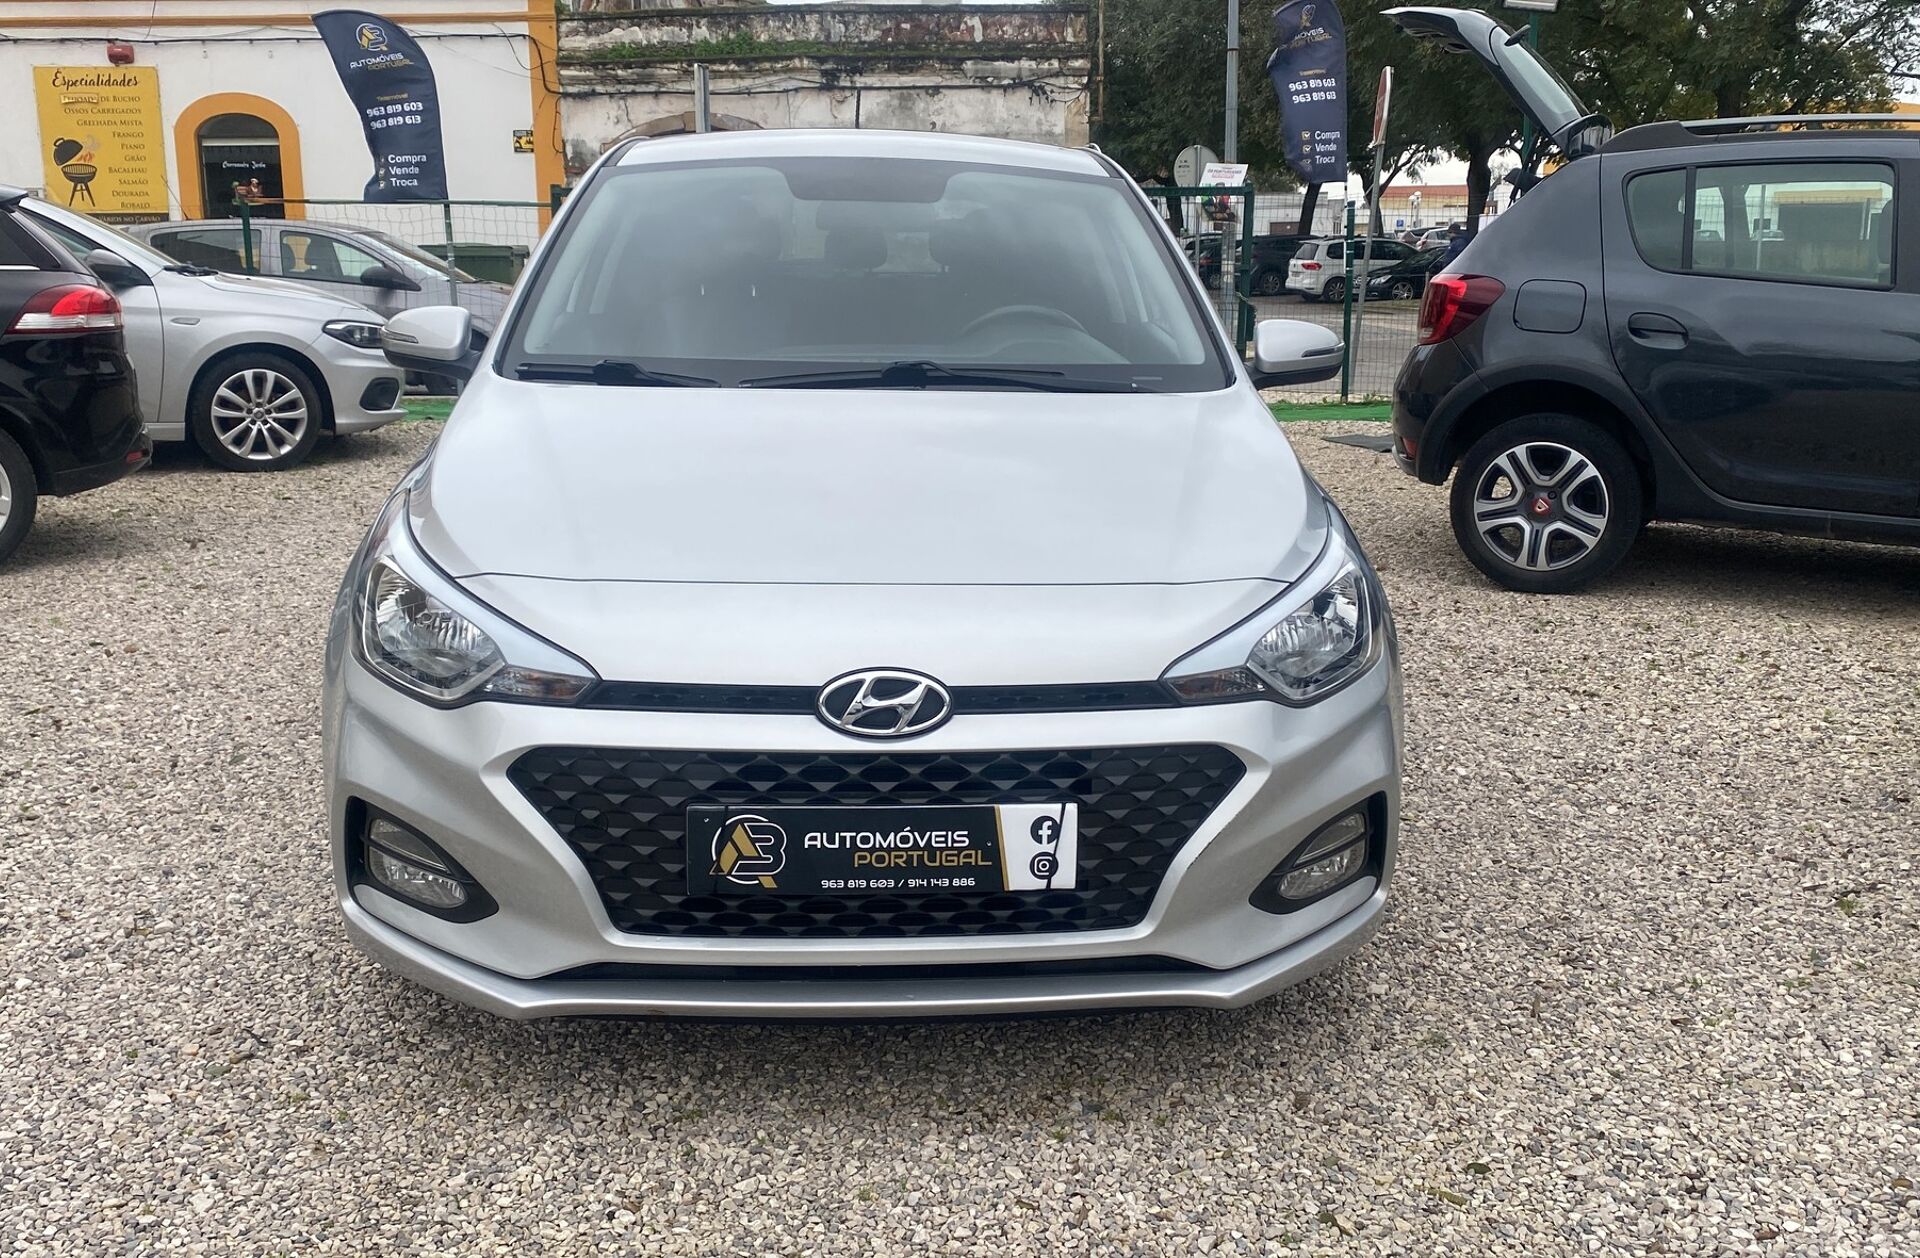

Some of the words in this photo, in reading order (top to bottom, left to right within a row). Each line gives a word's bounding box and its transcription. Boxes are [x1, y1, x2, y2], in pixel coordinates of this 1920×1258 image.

[349, 52, 404, 69] AUTOMÓVEIS
[52, 68, 138, 91] Especialidades
[1288, 81, 1308, 92] 963
[1323, 78, 1336, 87] 603
[113, 95, 141, 103] BUCHO
[1292, 93, 1311, 104] 963
[1312, 91, 1326, 101] 819
[64, 107, 89, 115] OSSOS
[90, 107, 142, 115] CARREGADOS
[366, 106, 385, 118] 963
[386, 103, 402, 114] 819
[403, 101, 424, 112] 603
[76, 119, 118, 127] GRELHADA
[120, 119, 143, 127] MISTA
[370, 118, 387, 130] 963
[387, 115, 404, 127] 819
[405, 115, 422, 124] 613
[112, 131, 144, 139] FRANGO
[1314, 142, 1337, 152] Vende
[124, 154, 146, 162] GRÃO
[388, 154, 427, 164] Compra
[1315, 154, 1336, 165] Troca
[388, 165, 420, 175] Vende
[118, 178, 149, 186] SALMÃO
[389, 177, 418, 187] Troca
[120, 202, 151, 210] ROBALO
[804, 826, 970, 849] AUTOMÓVEIS
[854, 850, 993, 867] PORTUGAL
[821, 880, 844, 888] 963
[847, 879, 866, 888] 819
[869, 879, 895, 888] 603
[908, 878, 928, 888] 914
[930, 878, 949, 887] 143
[952, 877, 976, 887] 886
